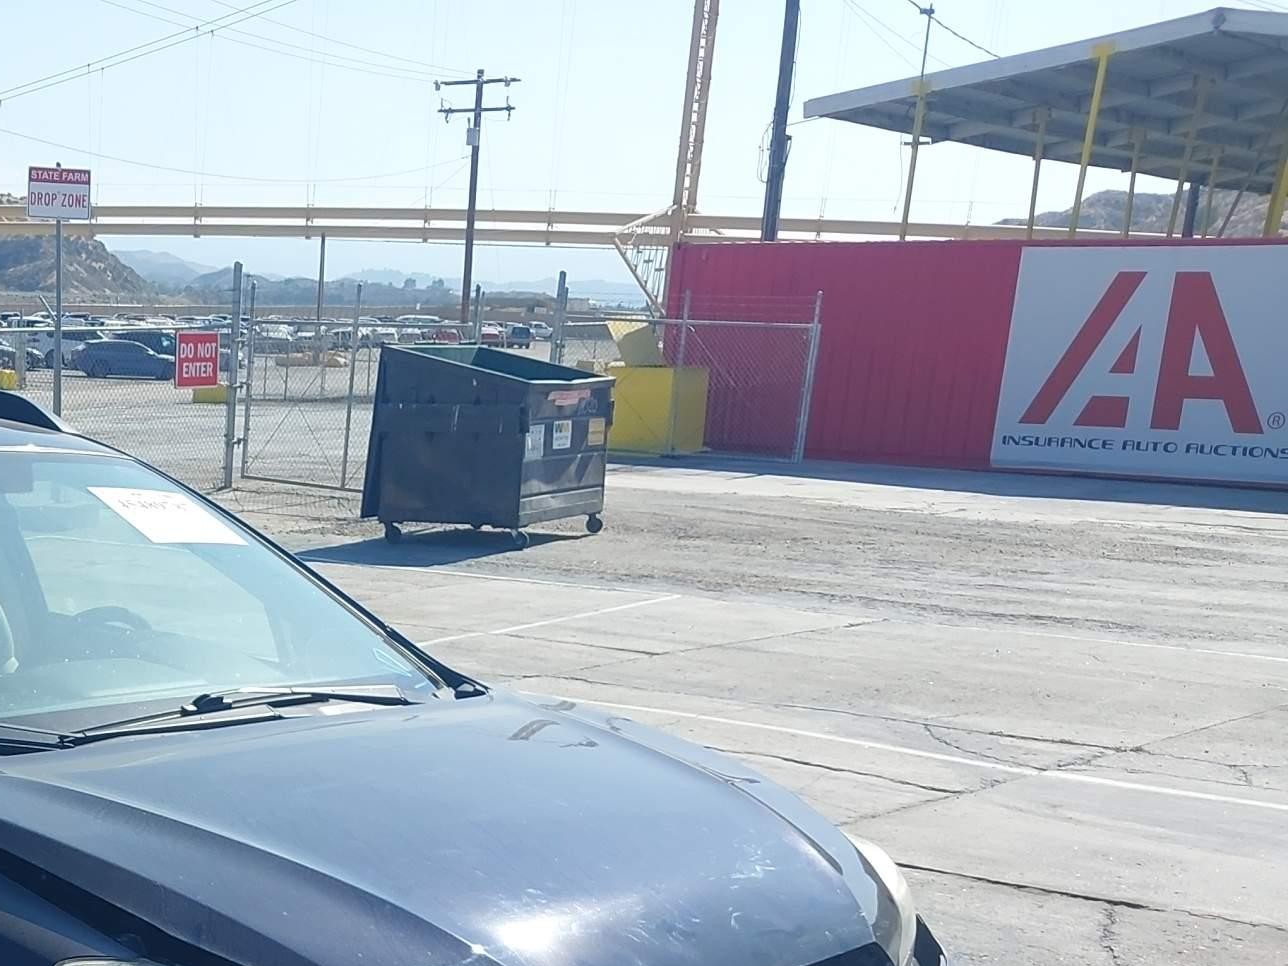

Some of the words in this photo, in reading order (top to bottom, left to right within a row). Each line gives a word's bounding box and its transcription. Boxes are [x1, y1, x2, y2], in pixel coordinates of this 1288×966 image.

[31, 169, 60, 181] STATE
[62, 171, 89, 182] FARM
[30, 191, 58, 207] DROP
[61, 193, 88, 209] ZONE
[180, 342, 194, 359] DO
[197, 341, 217, 359] NOT
[182, 361, 214, 378] ENTER
[1001, 434, 1115, 452] INSURANCE
[1121, 438, 1179, 455] AUTO
[1184, 442, 1288, 460] AUCTIONS
